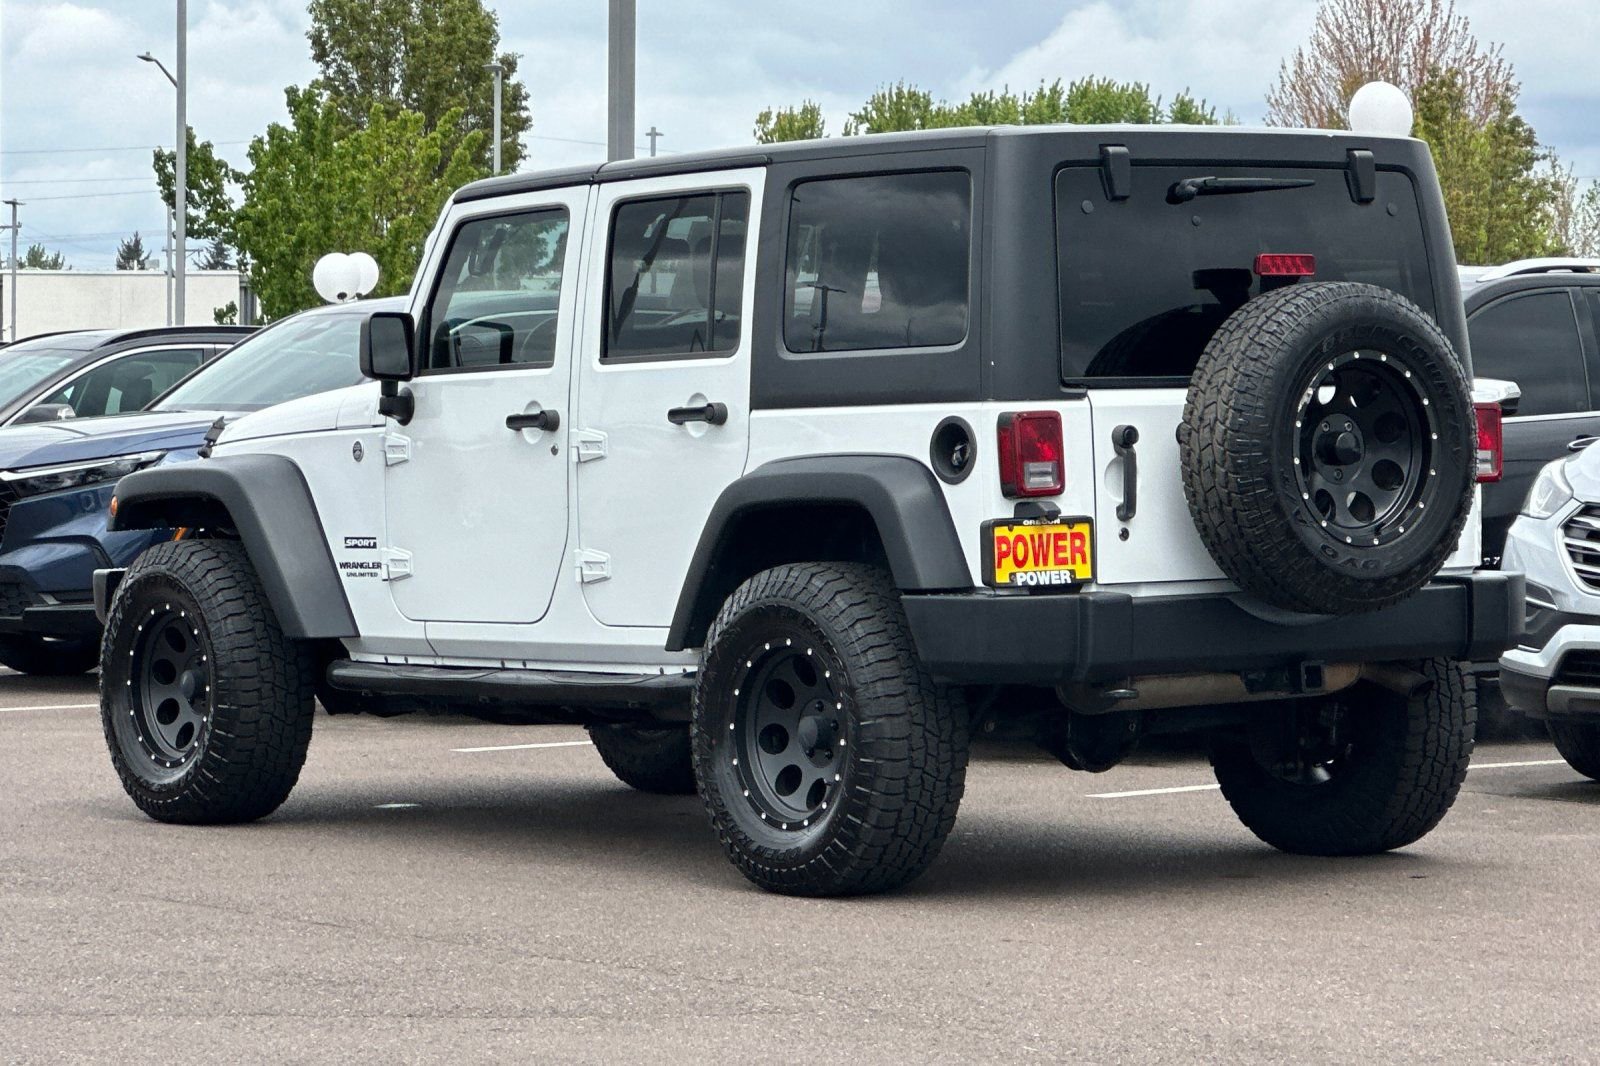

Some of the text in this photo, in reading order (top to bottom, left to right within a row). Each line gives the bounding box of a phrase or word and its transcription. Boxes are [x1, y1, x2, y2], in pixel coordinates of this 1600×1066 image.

[345, 538, 377, 548] SPORT
[996, 531, 1087, 569] POWER
[339, 562, 382, 570] WRANGLER
[1016, 570, 1071, 586] POWER
